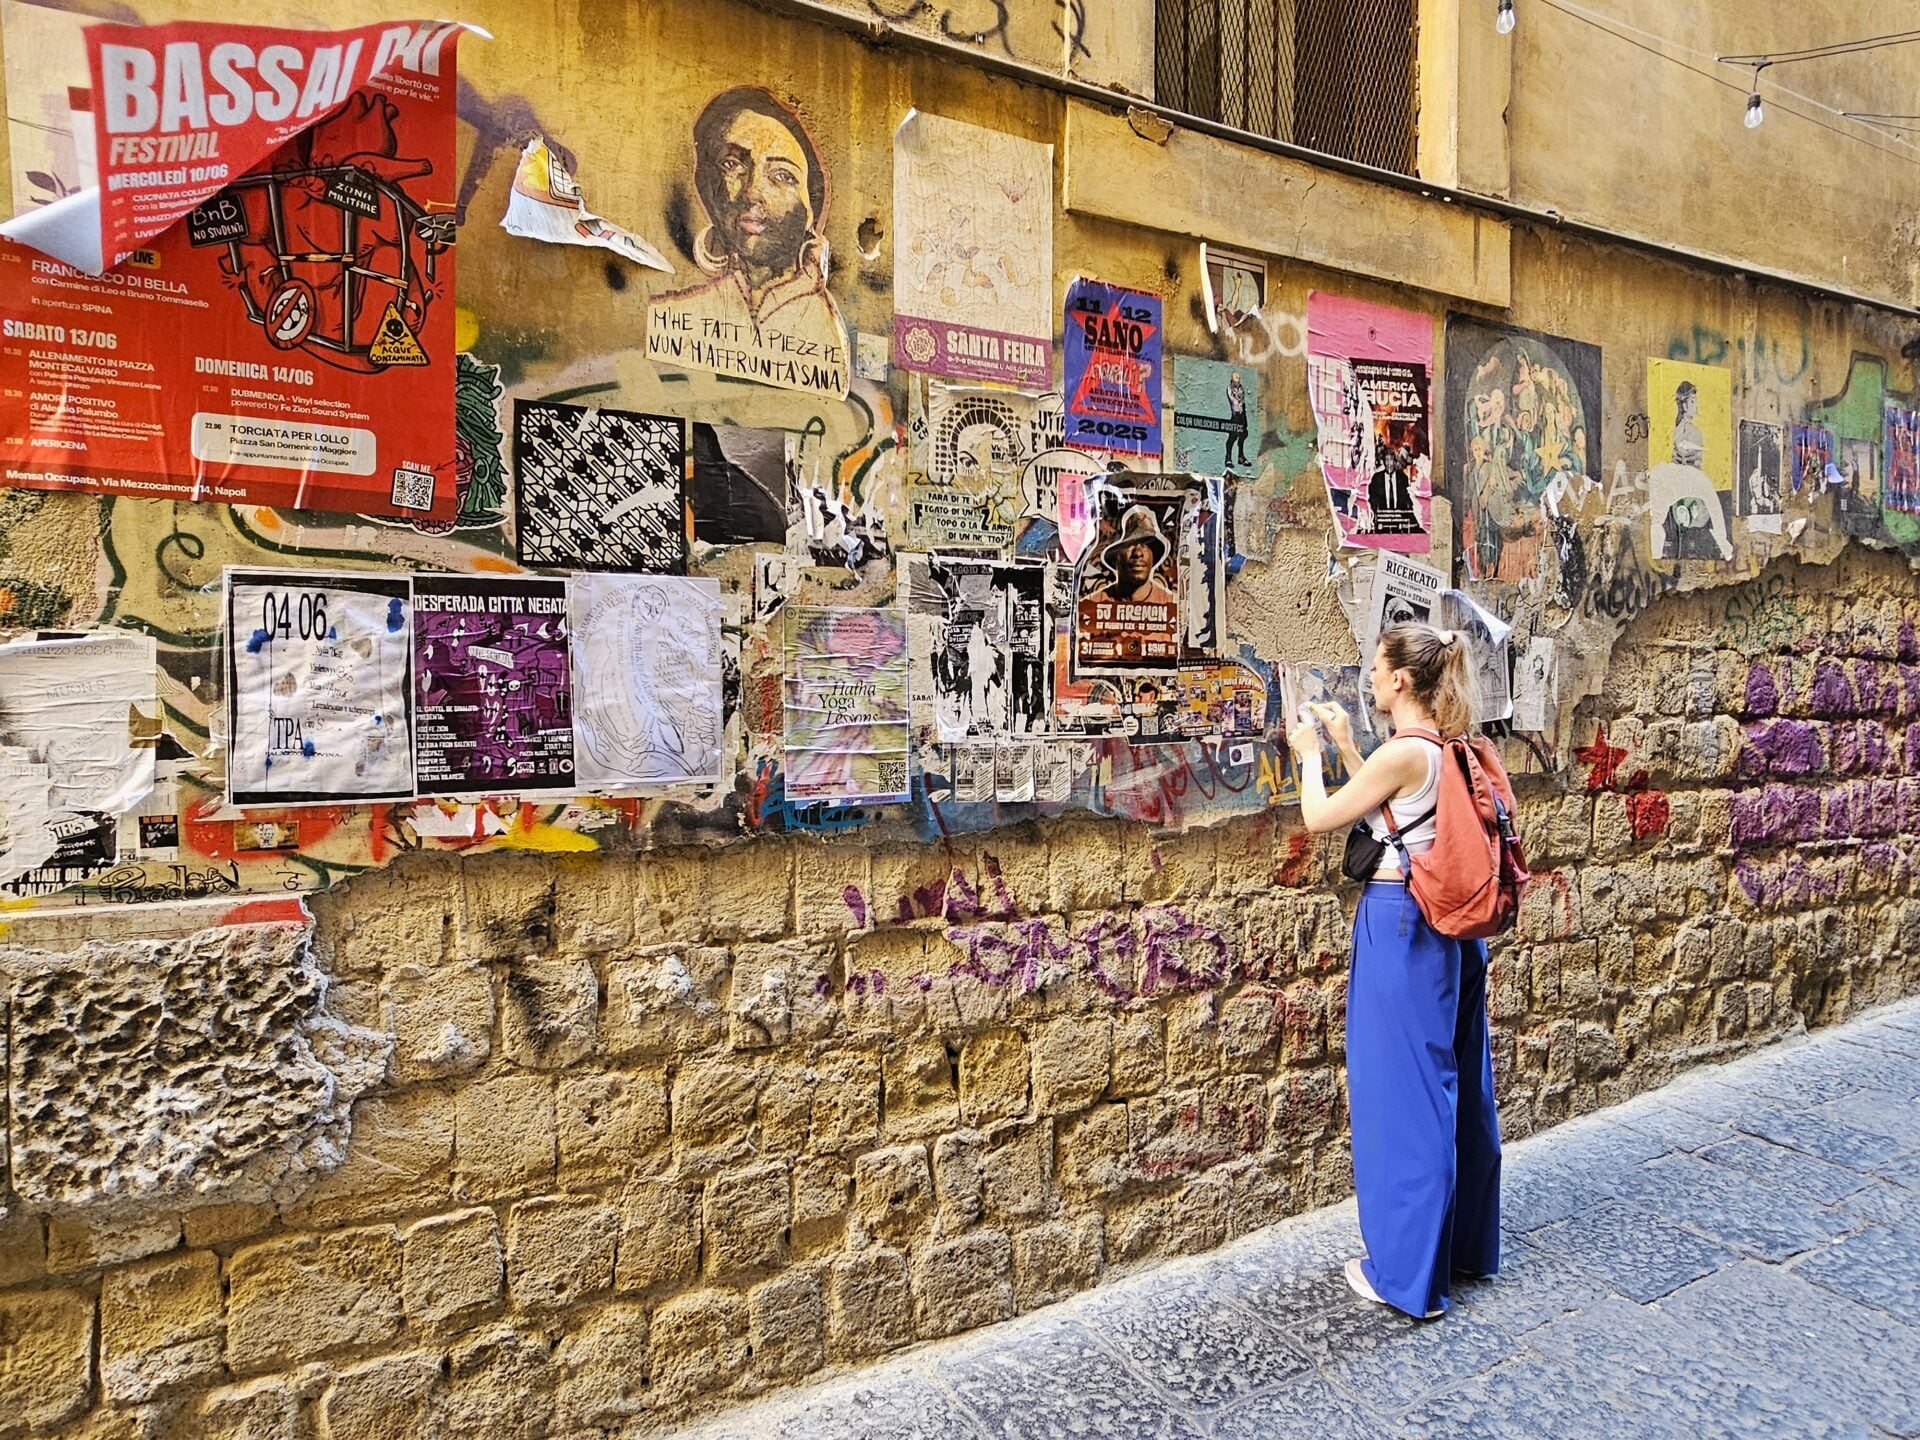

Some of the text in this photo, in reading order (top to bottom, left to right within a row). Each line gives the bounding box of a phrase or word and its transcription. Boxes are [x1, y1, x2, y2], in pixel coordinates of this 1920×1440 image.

[394, 87, 409, 98] per
[410, 90, 417, 98] le
[423, 82, 439, 92] che
[109, 132, 219, 166] FESTIVAL
[108, 164, 229, 191] MERCOLEDÌ 10/06
[133, 189, 179, 202] CUCINATA
[335, 182, 372, 200] ZONA
[328, 190, 378, 214] MILITARE
[192, 200, 237, 225] BnB
[194, 222, 244, 240] NO STUDENTI
[32, 276, 49, 285] con
[50, 279, 89, 292] Carmine
[91, 284, 100, 292] di
[101, 286, 118, 296] Leo
[127, 289, 154, 300] Bruno
[156, 294, 209, 309] Tommasello
[127, 274, 141, 287] DI
[144, 277, 188, 294] BELLA
[32, 296, 113, 315] in apertura SPINA
[1122, 306, 1152, 324] 12
[3, 319, 118, 350] SABATO 13/06
[701, 317, 744, 342] FATT
[768, 329, 819, 357] PIEZZ
[823, 346, 841, 364] PE
[1084, 315, 1143, 353] SANO
[381, 346, 411, 354] ACQUE
[650, 333, 683, 357] NUN
[947, 330, 1000, 360] SANTA
[1003, 340, 1045, 367] FEIRA
[29, 349, 155, 373] ALLENAMENTO IN PIAZZA
[370, 353, 424, 362] CONTAMINATE
[29, 360, 118, 377] MONTECALVARIO
[195, 356, 314, 386] DOMENICA 14/06
[68, 395, 116, 408] POSITIVO
[231, 388, 351, 409] DUBMENICA Vinyl selection
[77, 407, 118, 418] Palumbo
[231, 399, 370, 421] powered by Fe Zion Sound System
[230, 424, 349, 445] TORCIATA PER LOLLO
[1078, 419, 1148, 441] 2025
[31, 438, 88, 451] APERICENA
[230, 436, 357, 456] Piazza San Domenico Maggiore
[402, 460, 431, 474] SCAN ME
[6, 469, 44, 481] Mensa
[45, 472, 100, 488] Occupata,
[101, 477, 119, 487] Via
[199, 484, 213, 496] 14,
[215, 486, 247, 497] Napoli
[952, 507, 960, 515] DI
[937, 518, 957, 528] TOPO
[960, 521, 966, 529] O
[969, 522, 978, 530] LA
[949, 532, 970, 541] DI UN
[1386, 560, 1438, 590] RICERCATO
[413, 594, 485, 613] DESPERADA
[528, 597, 568, 614] NEGATA
[1386, 584, 1407, 597] ARTISTA
[1412, 593, 1431, 606] STRADA
[263, 592, 328, 641] 04 06
[1096, 603, 1112, 620] DJ
[73, 644, 114, 656] 2026
[832, 681, 876, 697] Hatha
[818, 694, 855, 711] Yoga
[825, 711, 879, 725] Lessons
[273, 717, 304, 749] TPA
[28, 867, 62, 882] START
[65, 867, 84, 881] ORE
